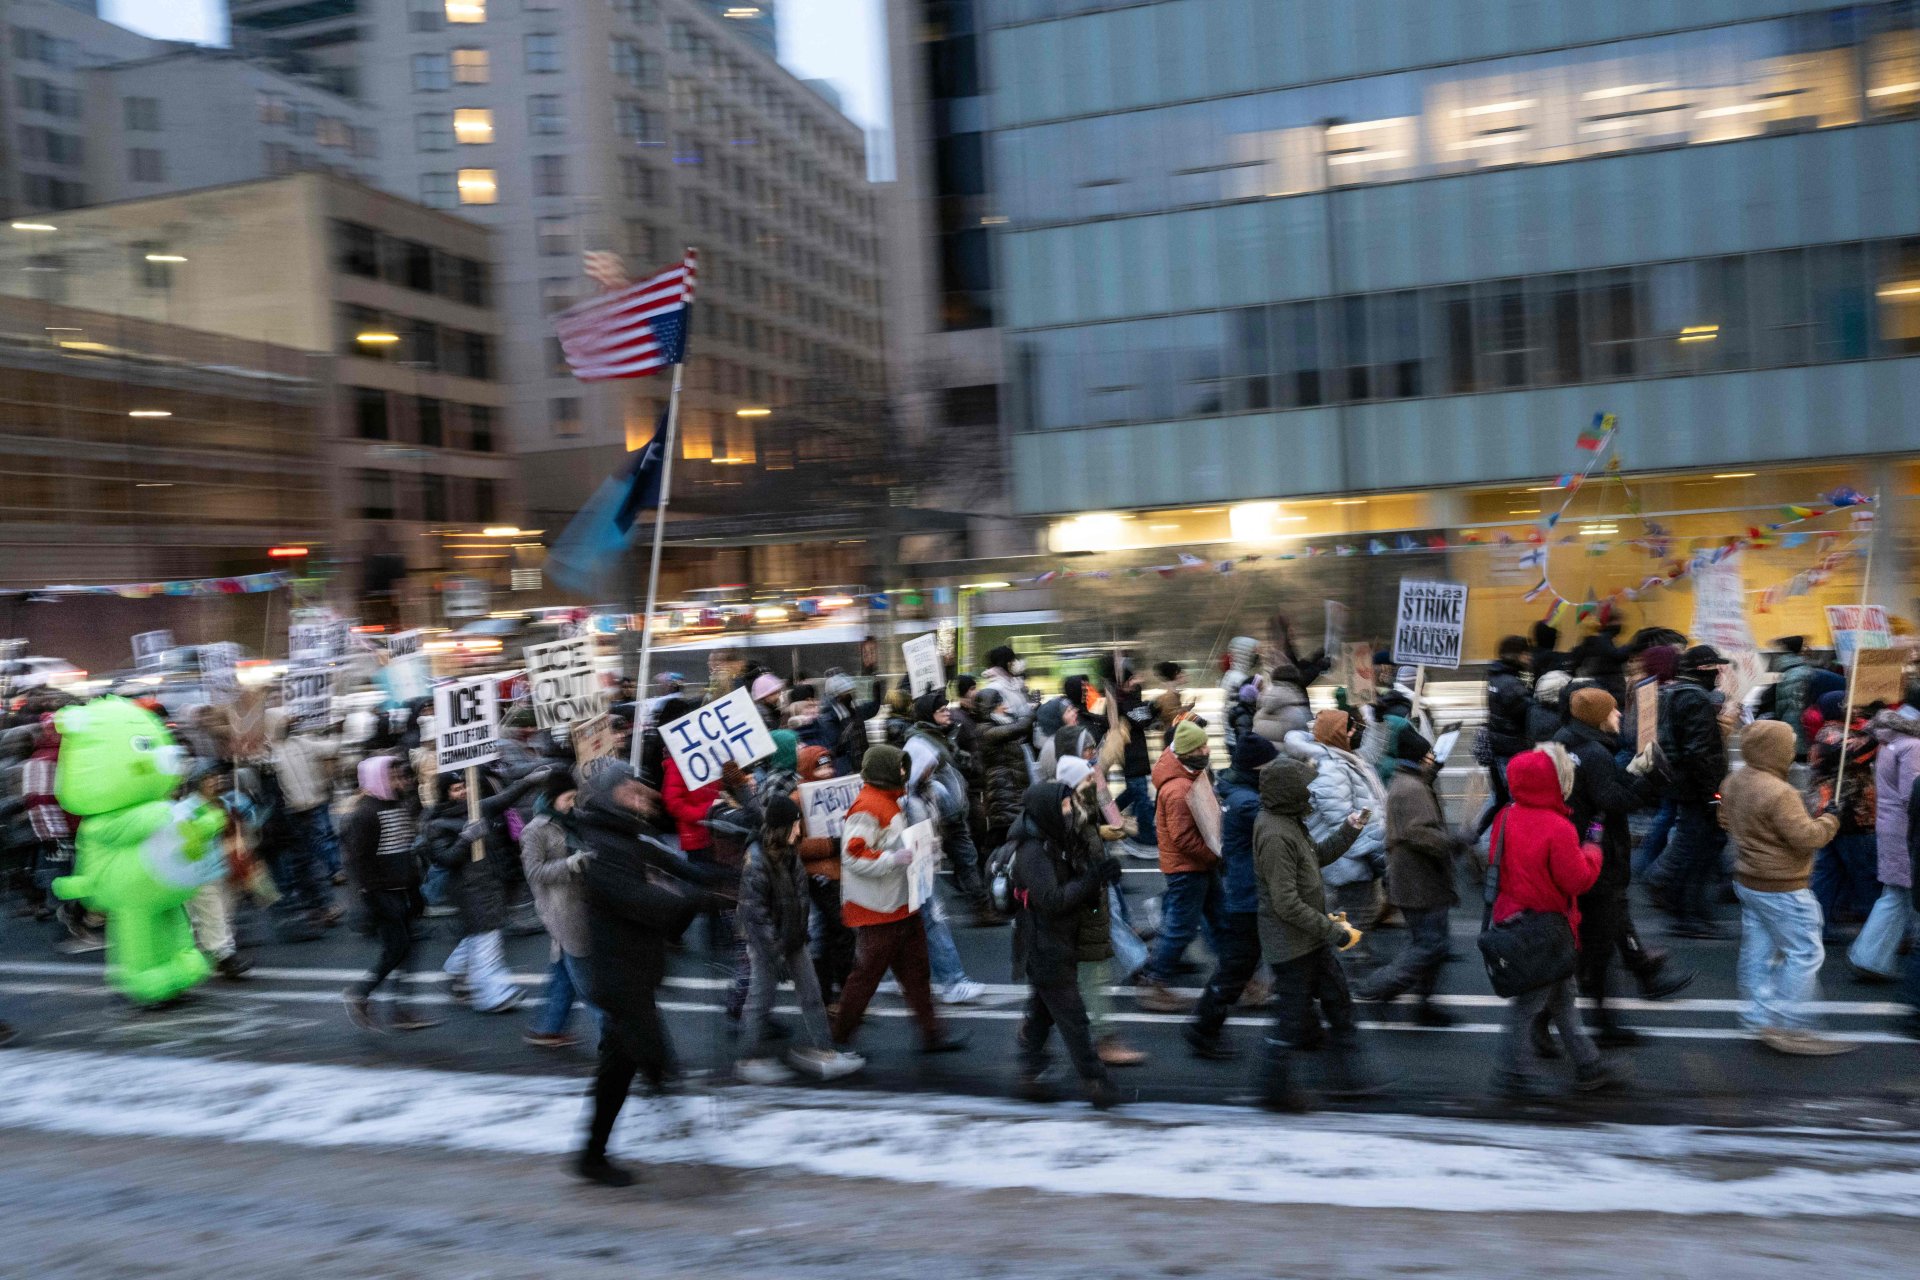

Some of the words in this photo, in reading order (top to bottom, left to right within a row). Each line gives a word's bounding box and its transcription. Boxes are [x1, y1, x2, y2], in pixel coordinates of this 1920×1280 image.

[1402, 597, 1462, 625] STRIKE
[1398, 629, 1460, 657] RACISM
[1404, 624, 1458, 637] AGAINST
[531, 641, 588, 673] ICE
[535, 670, 595, 703] OUT
[448, 685, 483, 727] ICE
[670, 700, 747, 754] ICE
[688, 728, 755, 782] OUT
